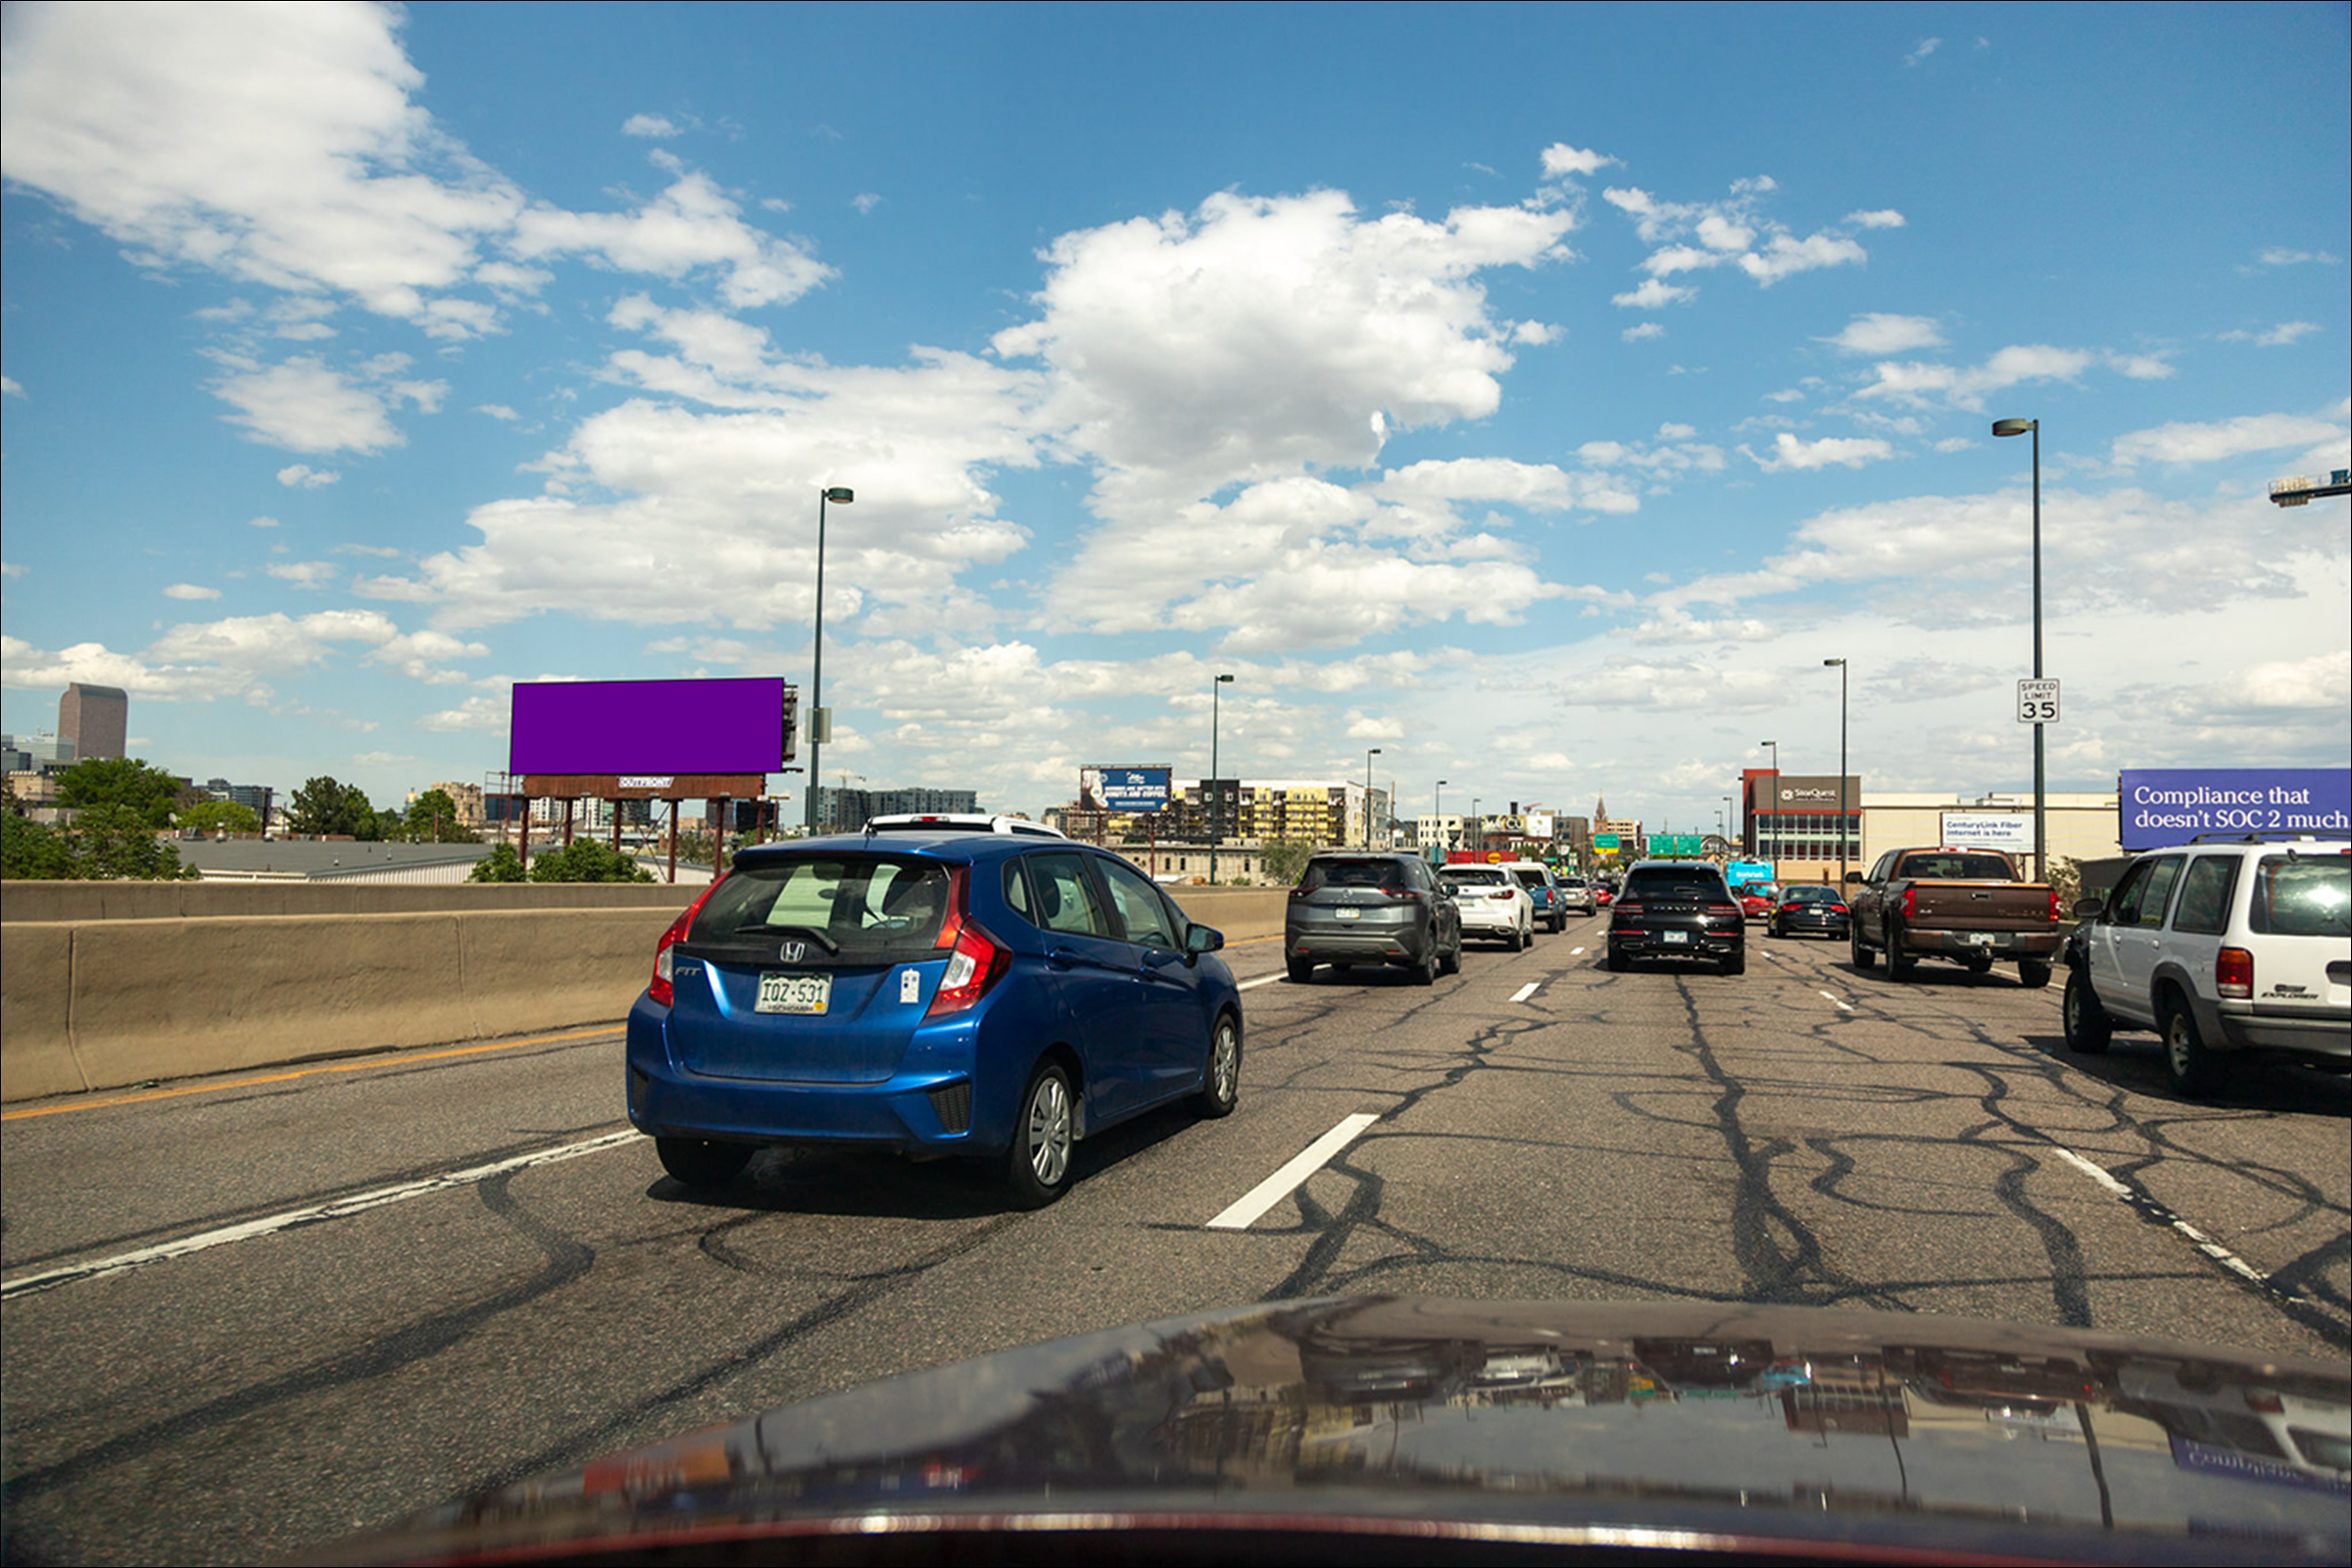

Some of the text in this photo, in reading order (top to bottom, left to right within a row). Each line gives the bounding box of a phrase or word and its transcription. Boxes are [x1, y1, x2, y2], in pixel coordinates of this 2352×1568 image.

[2022, 682, 2056, 691] SPEED
[2022, 702, 2056, 718] 35
[2134, 786, 2310, 808] Compliance that
[2134, 809, 2211, 828] doesn't
[2215, 809, 2263, 828] SOC
[2268, 809, 2280, 828] 2
[674, 965, 702, 976] FIT
